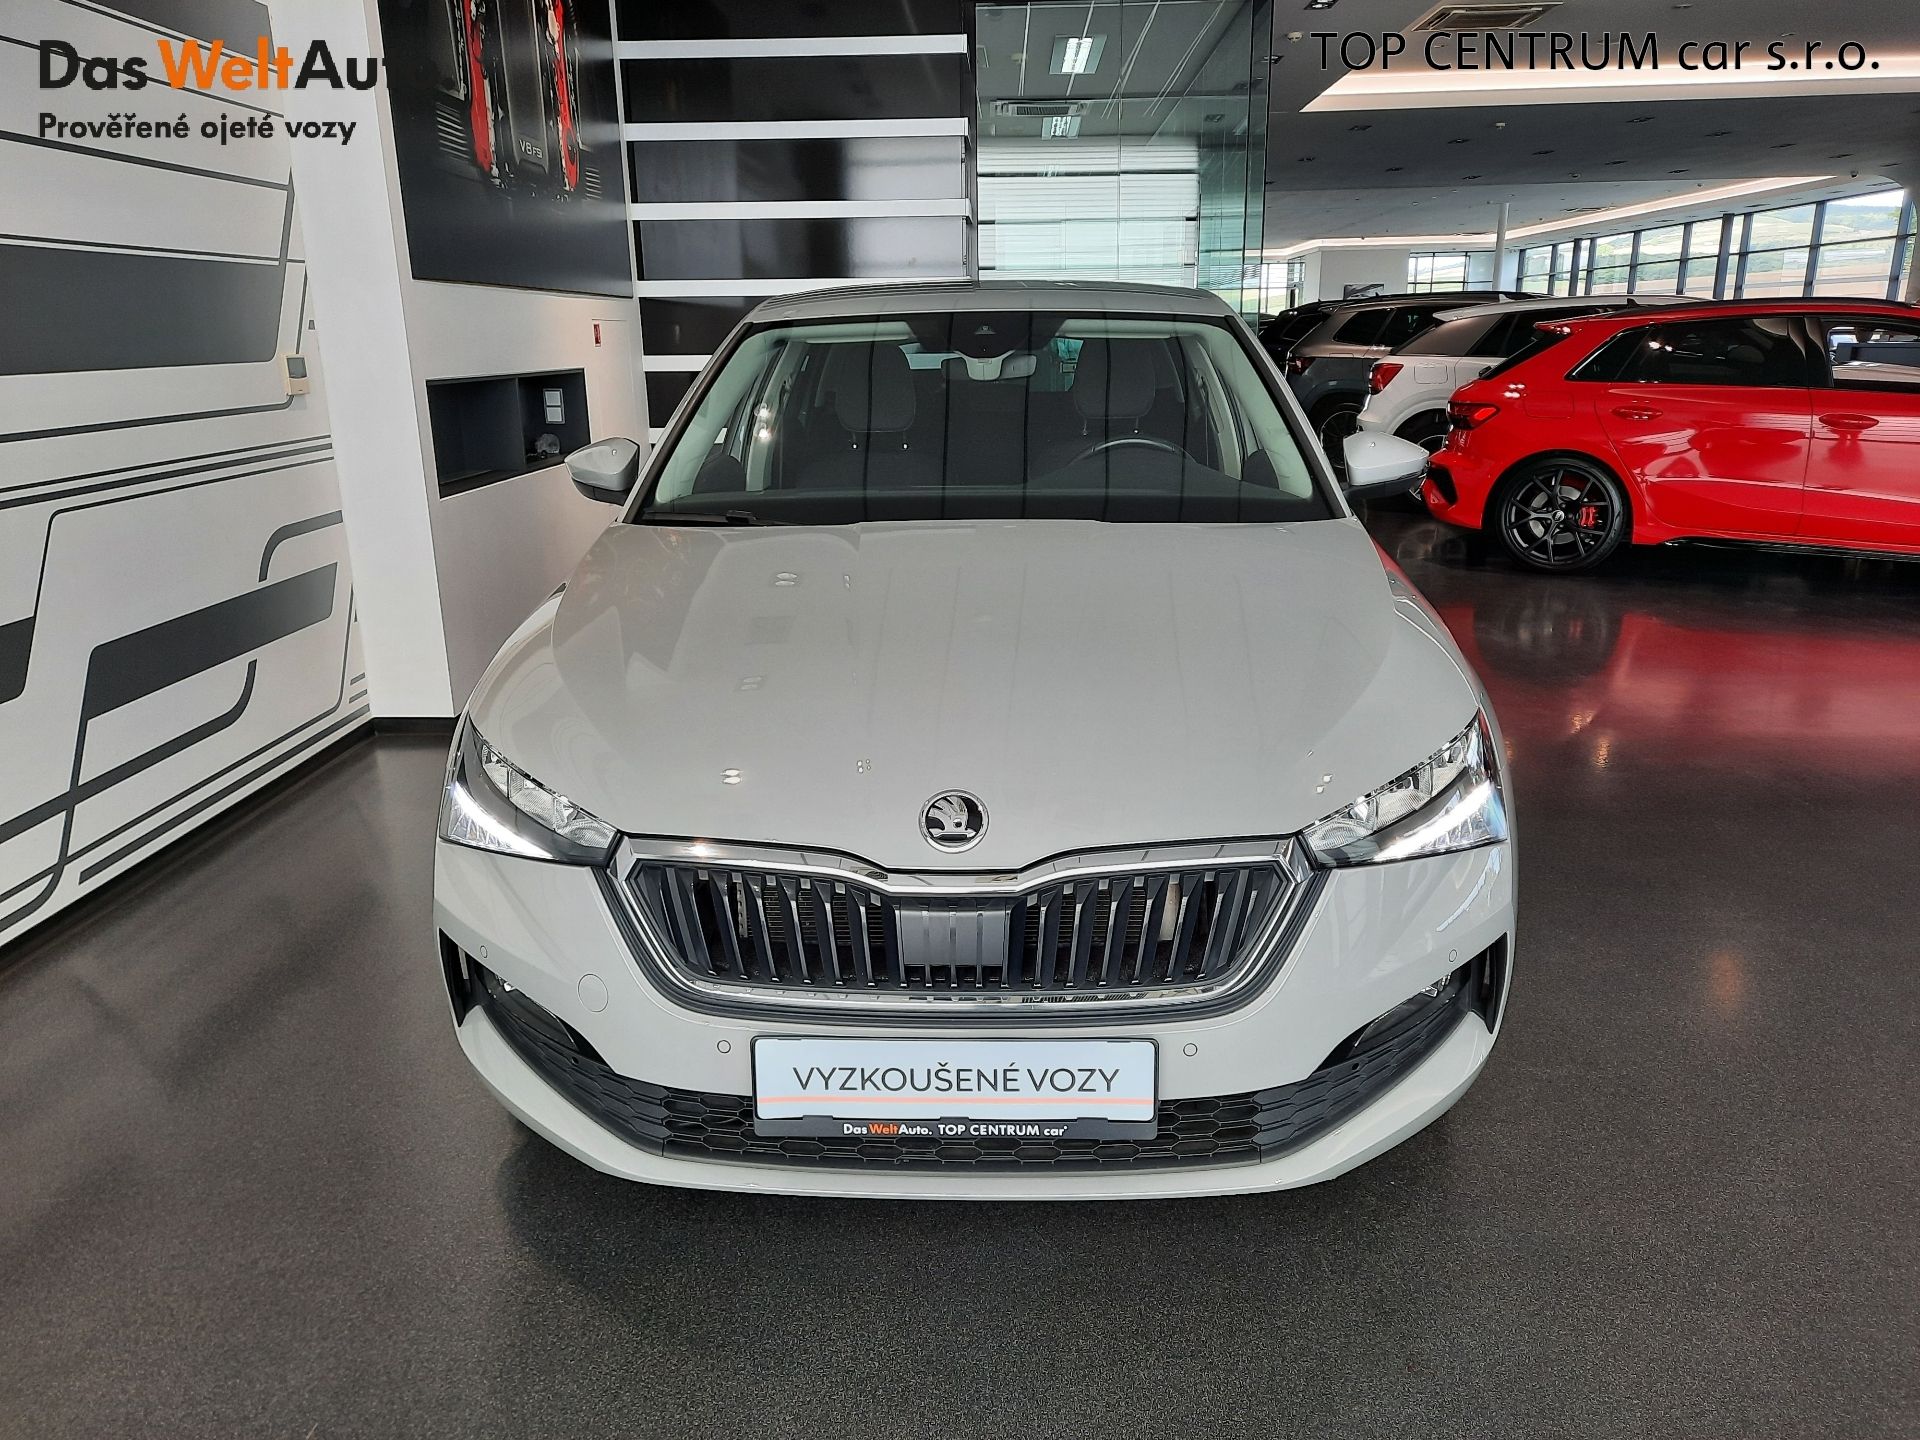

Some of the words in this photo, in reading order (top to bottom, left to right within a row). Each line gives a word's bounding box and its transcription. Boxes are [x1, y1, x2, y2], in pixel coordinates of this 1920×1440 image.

[793, 1062, 1020, 1093] VYZKOUŠENÉ
[1027, 1067, 1120, 1093] VOZY
[938, 1124, 966, 1136] TOP
[969, 1125, 1040, 1136] CENTRUM
